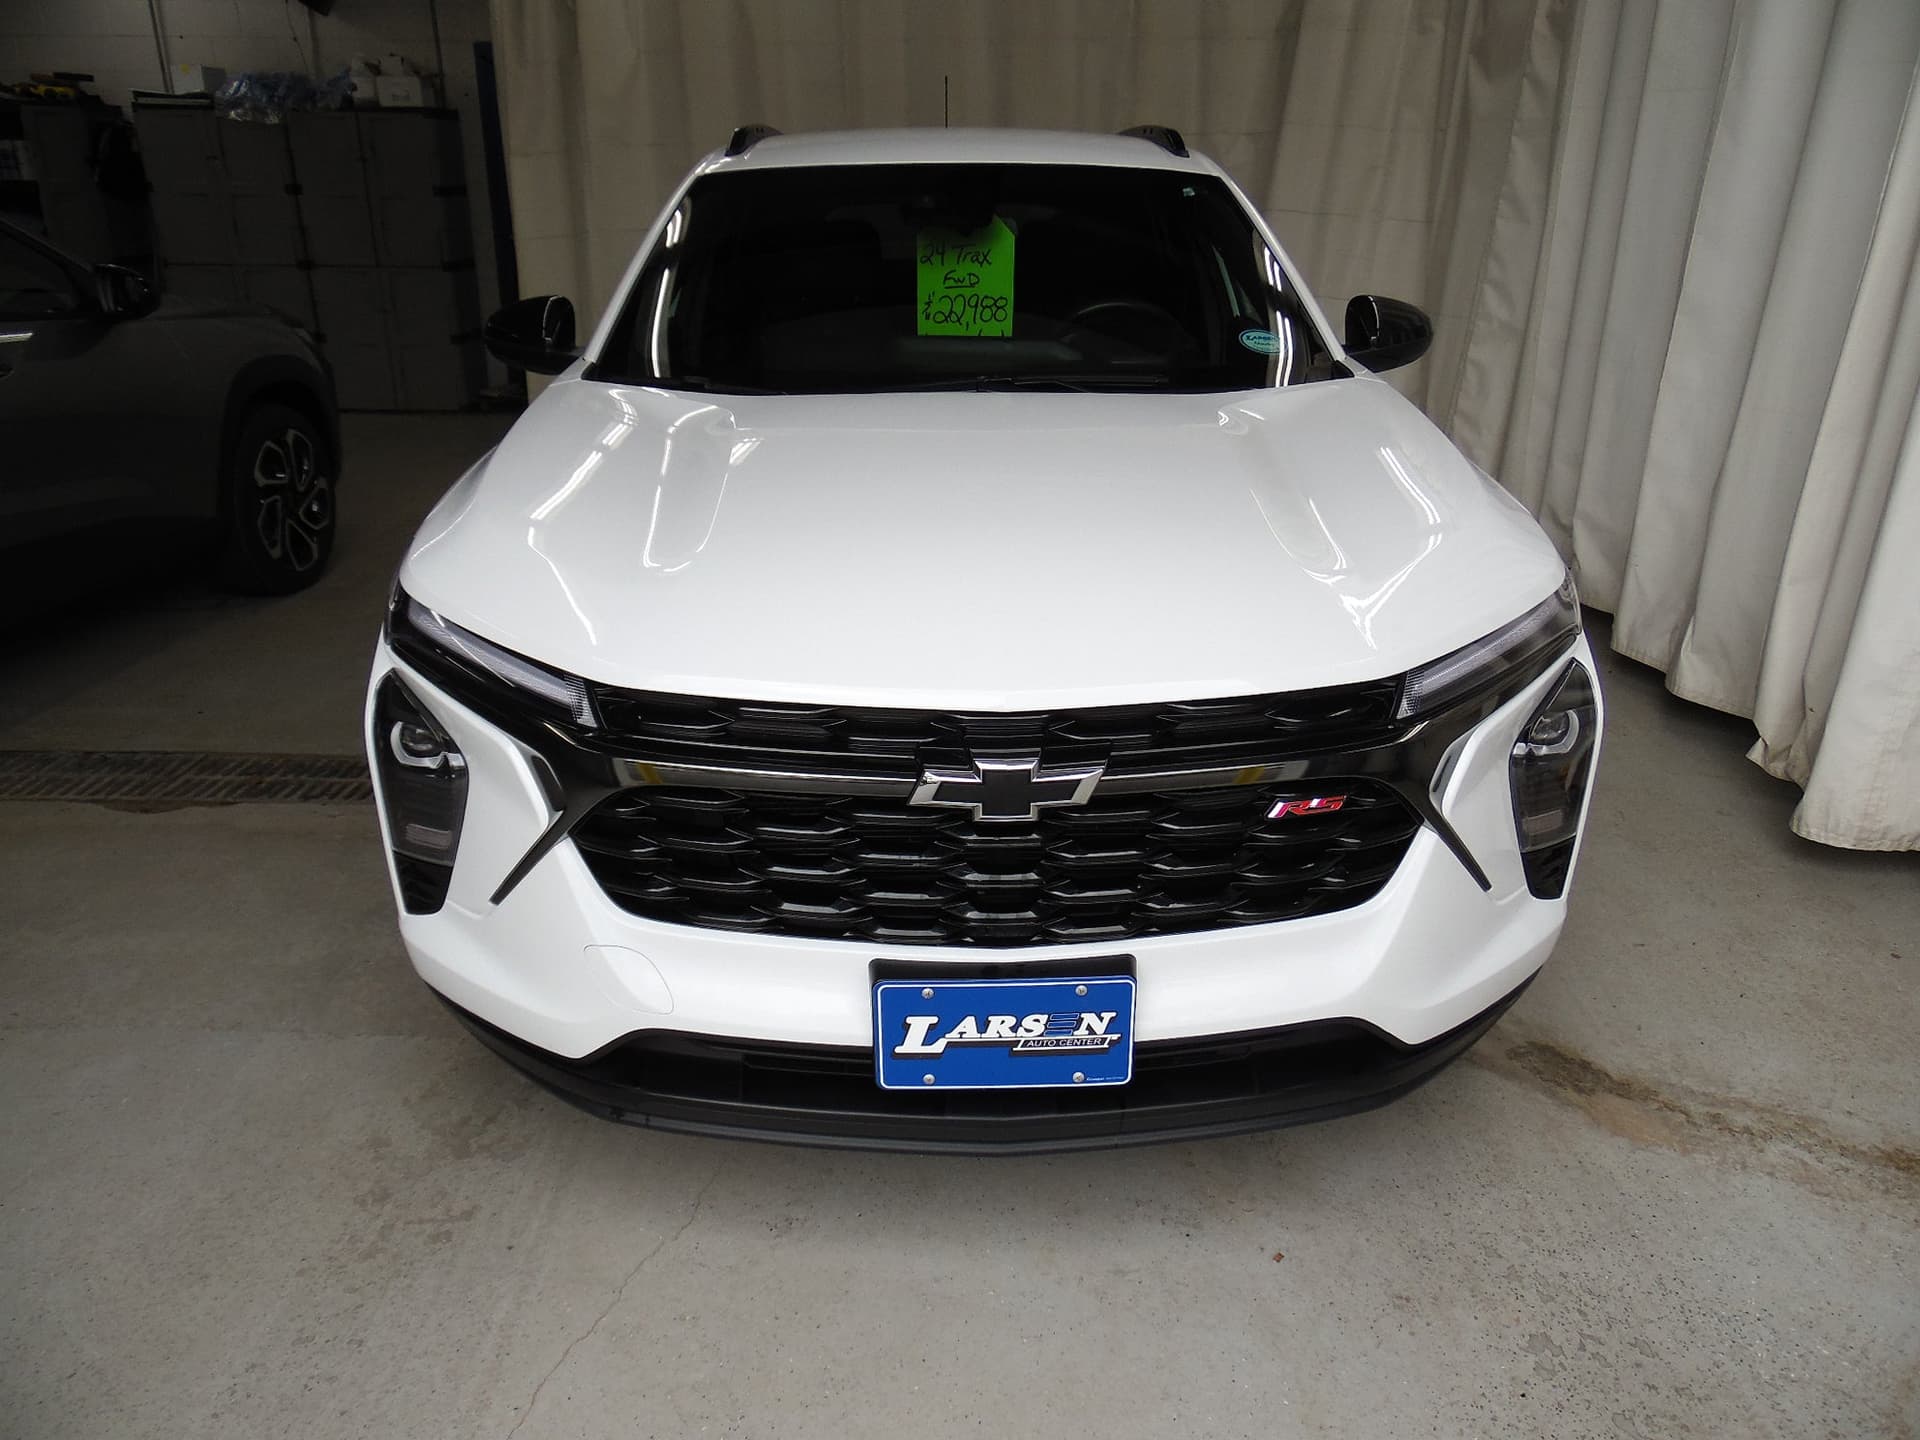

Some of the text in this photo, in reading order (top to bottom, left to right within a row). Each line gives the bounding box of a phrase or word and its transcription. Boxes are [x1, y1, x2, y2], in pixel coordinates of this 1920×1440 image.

[952, 244, 992, 267] Trax
[922, 292, 1008, 331] $22,988
[1267, 796, 1346, 818] RS
[895, 1011, 1120, 1054] LARSEN
[1027, 1037, 1102, 1047] AUTO CENTER
